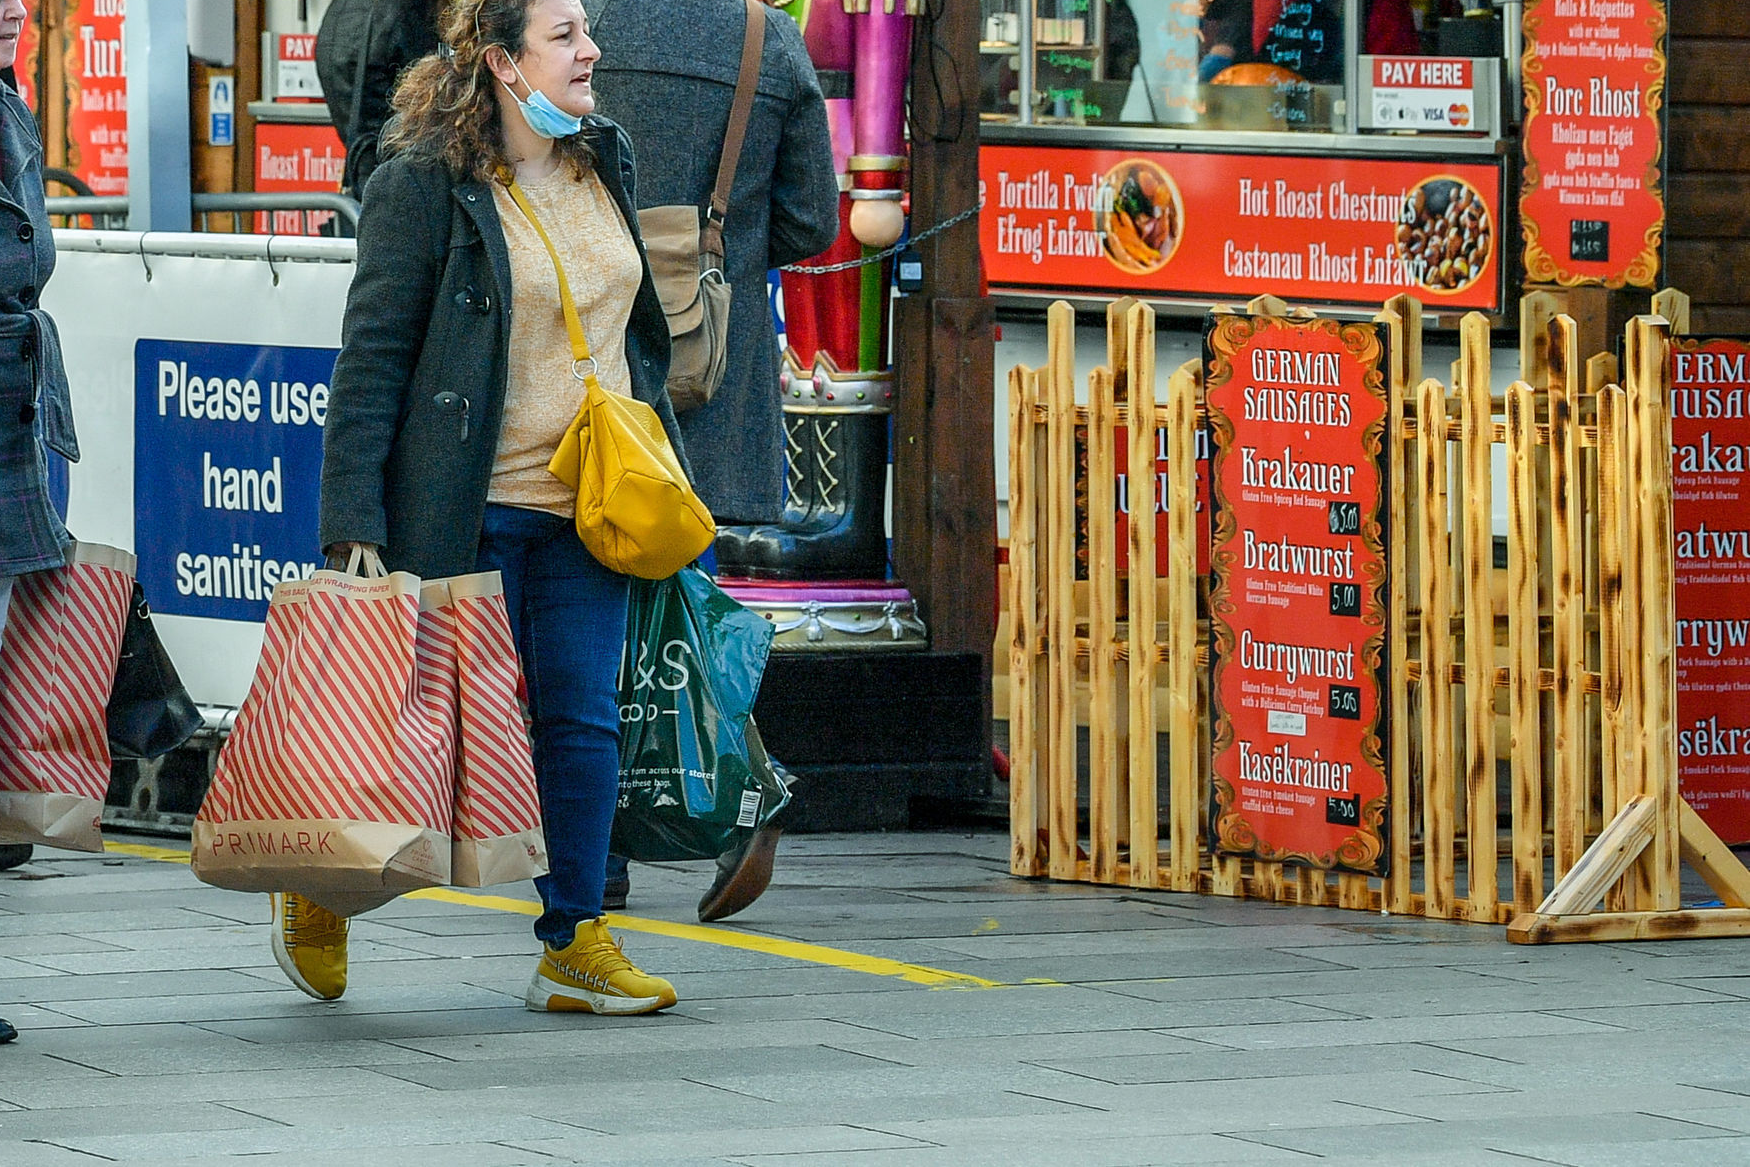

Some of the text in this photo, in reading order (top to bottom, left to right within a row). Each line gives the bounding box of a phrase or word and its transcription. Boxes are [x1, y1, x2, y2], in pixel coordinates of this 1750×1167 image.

[1579, 0, 1587, 17] &
[286, 38, 316, 58] PAY
[1568, 23, 1620, 39] with or without
[1382, 61, 1463, 85] PAY HERE
[1423, 108, 1444, 121] VISA
[1545, 75, 1641, 118] Porc Rhost
[261, 145, 298, 180] Roast
[998, 170, 1059, 210] Tortilla
[1239, 178, 1417, 224] Hot Roast Chestnuts
[998, 213, 1107, 264] Efrog Enfawr
[1224, 239, 1427, 287] Castanau Rhost Enfawr
[1251, 348, 1341, 387] GERMAN
[158, 360, 330, 427] Please use
[1243, 387, 1351, 427] SAUSAGES
[203, 451, 283, 513] hand
[1240, 446, 1355, 495] Krakauer
[176, 543, 317, 601] sanitiser
[1243, 530, 1355, 579] Bratwurst
[324, 578, 391, 594] WRAPPING PAPER
[1332, 584, 1355, 610] 5.00
[1240, 629, 1355, 684] Currywurst
[1241, 695, 1254, 708] with
[689, 769, 716, 780] stores
[1238, 741, 1352, 792] Kasëkrainer
[212, 830, 336, 857] PRIMARK
